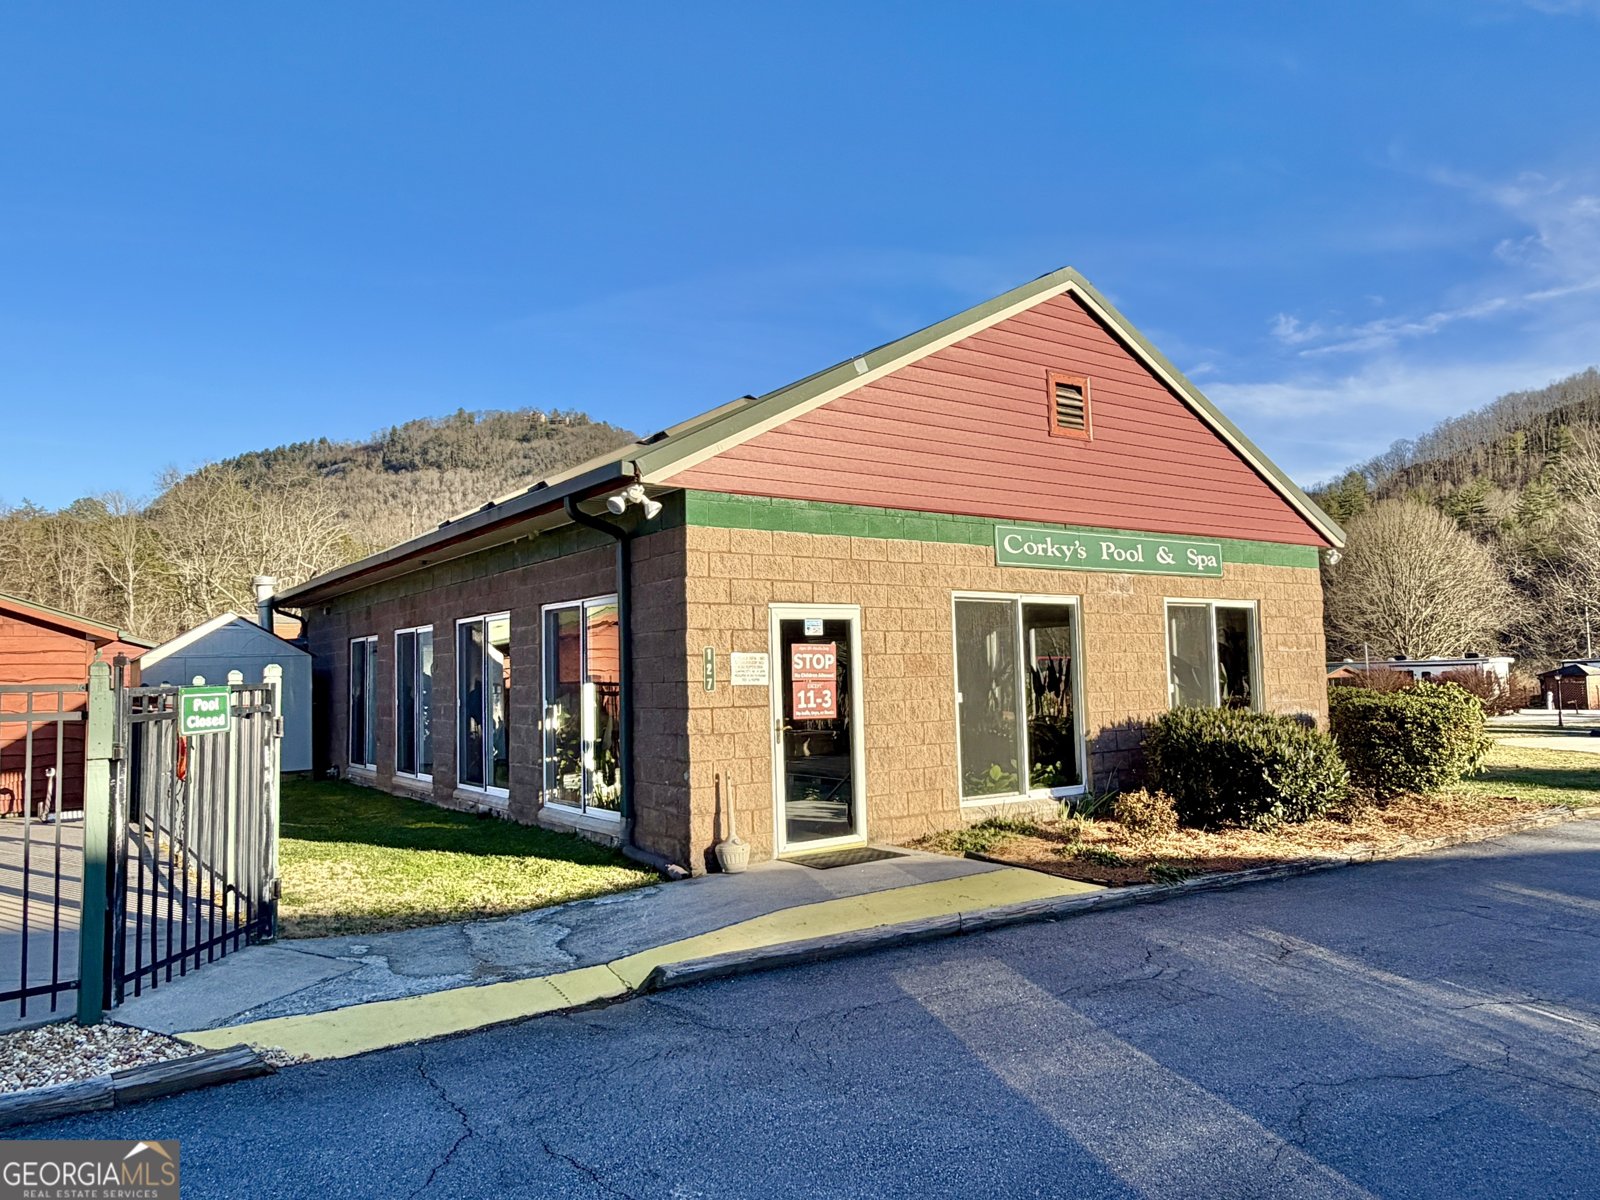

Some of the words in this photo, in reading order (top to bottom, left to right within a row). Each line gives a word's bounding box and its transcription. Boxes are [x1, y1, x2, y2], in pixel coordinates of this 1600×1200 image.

[1003, 534, 1087, 562] Corky's
[1100, 541, 1144, 563] Pool
[1156, 545, 1176, 565] &
[1187, 548, 1218, 570] Spa
[793, 653, 835, 670] STOP
[193, 697, 220, 712] Pool
[797, 689, 832, 709] 11-3
[186, 713, 226, 729] Closed
